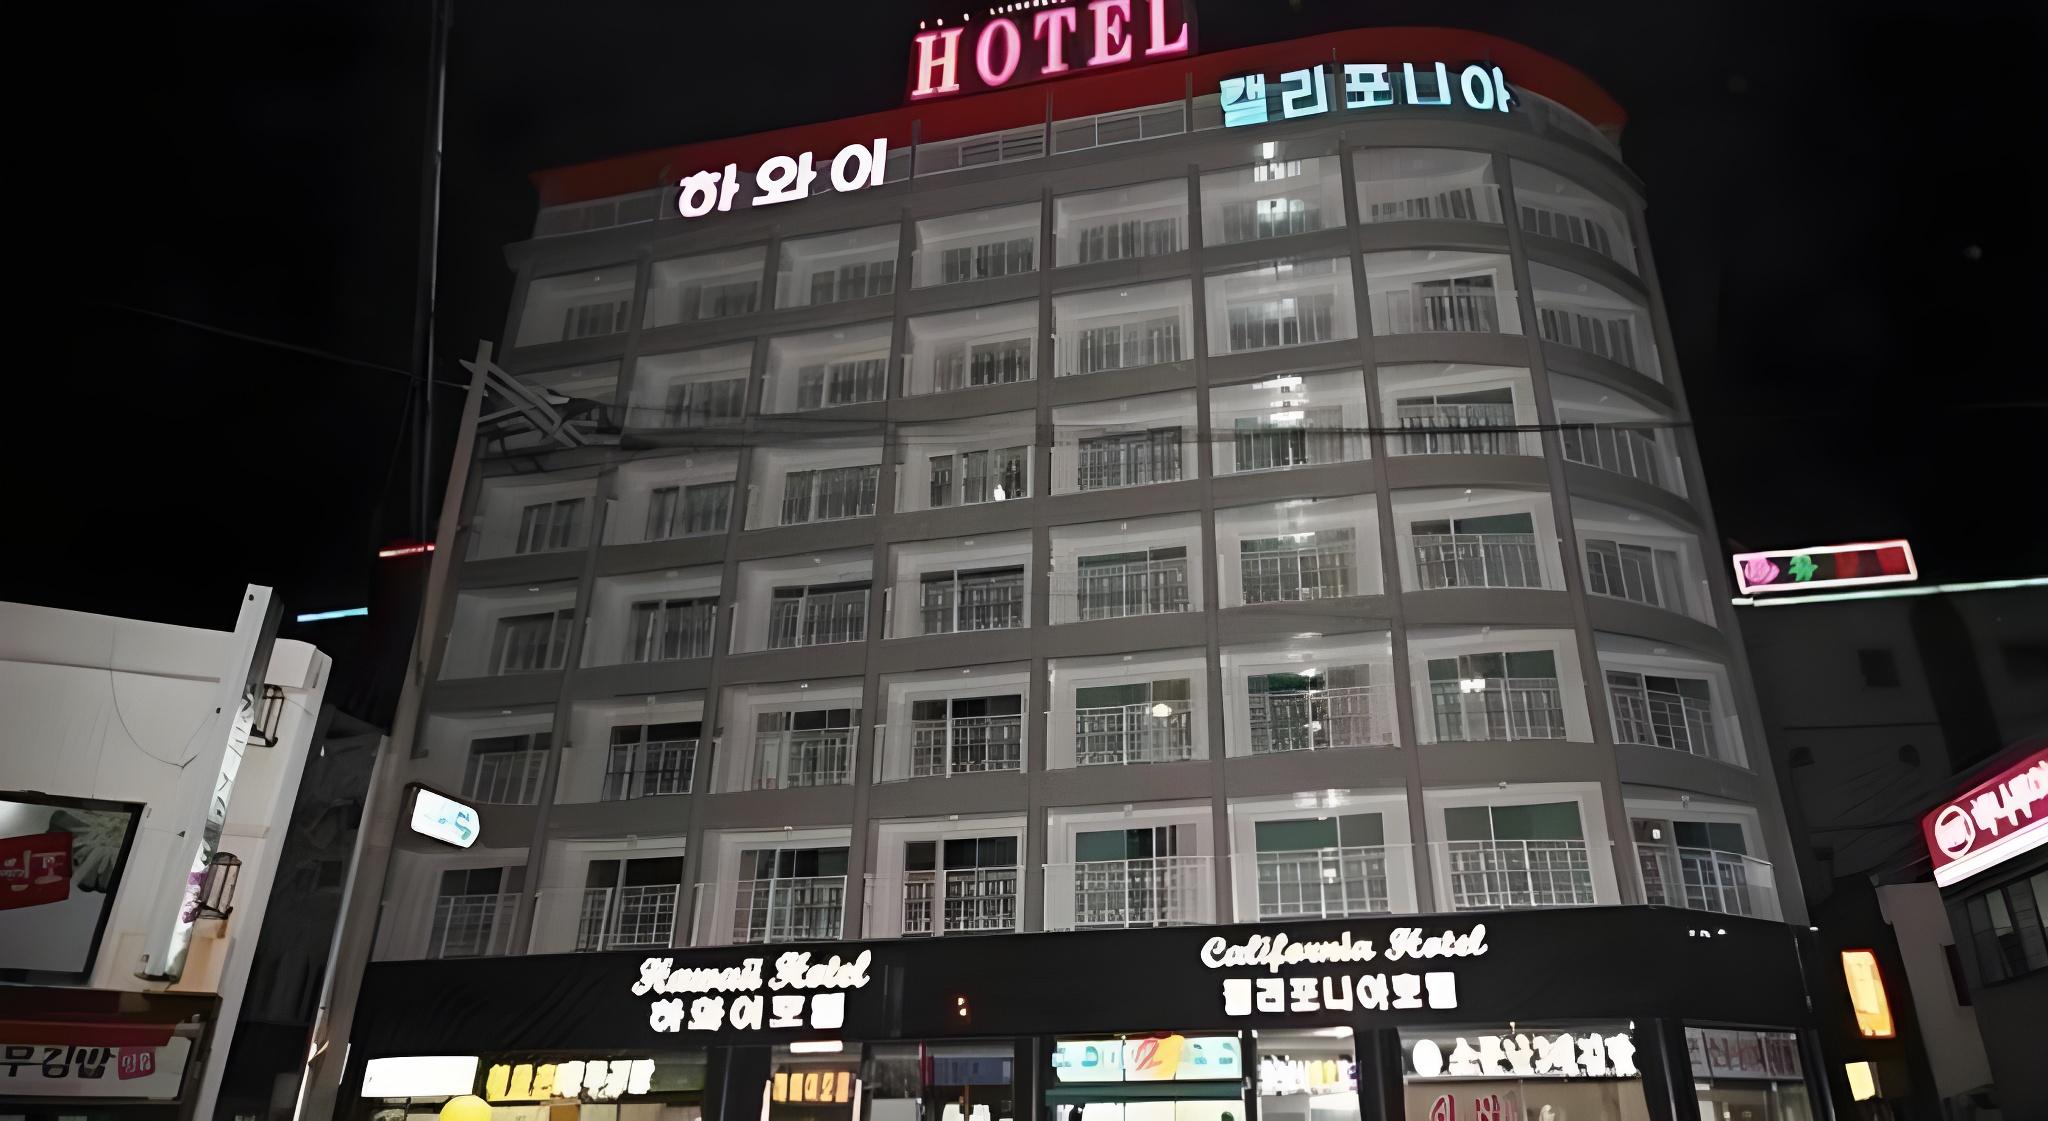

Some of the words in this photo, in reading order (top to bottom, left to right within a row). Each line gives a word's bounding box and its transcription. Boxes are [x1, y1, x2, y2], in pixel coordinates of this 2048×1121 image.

[911, 0, 1189, 96] HOTEL
[1220, 61, 1511, 128] 캘리포니아
[679, 138, 887, 217] 하와이
[650, 992, 845, 1032] 하와이호
[1223, 972, 1457, 1015] 리포니아호
